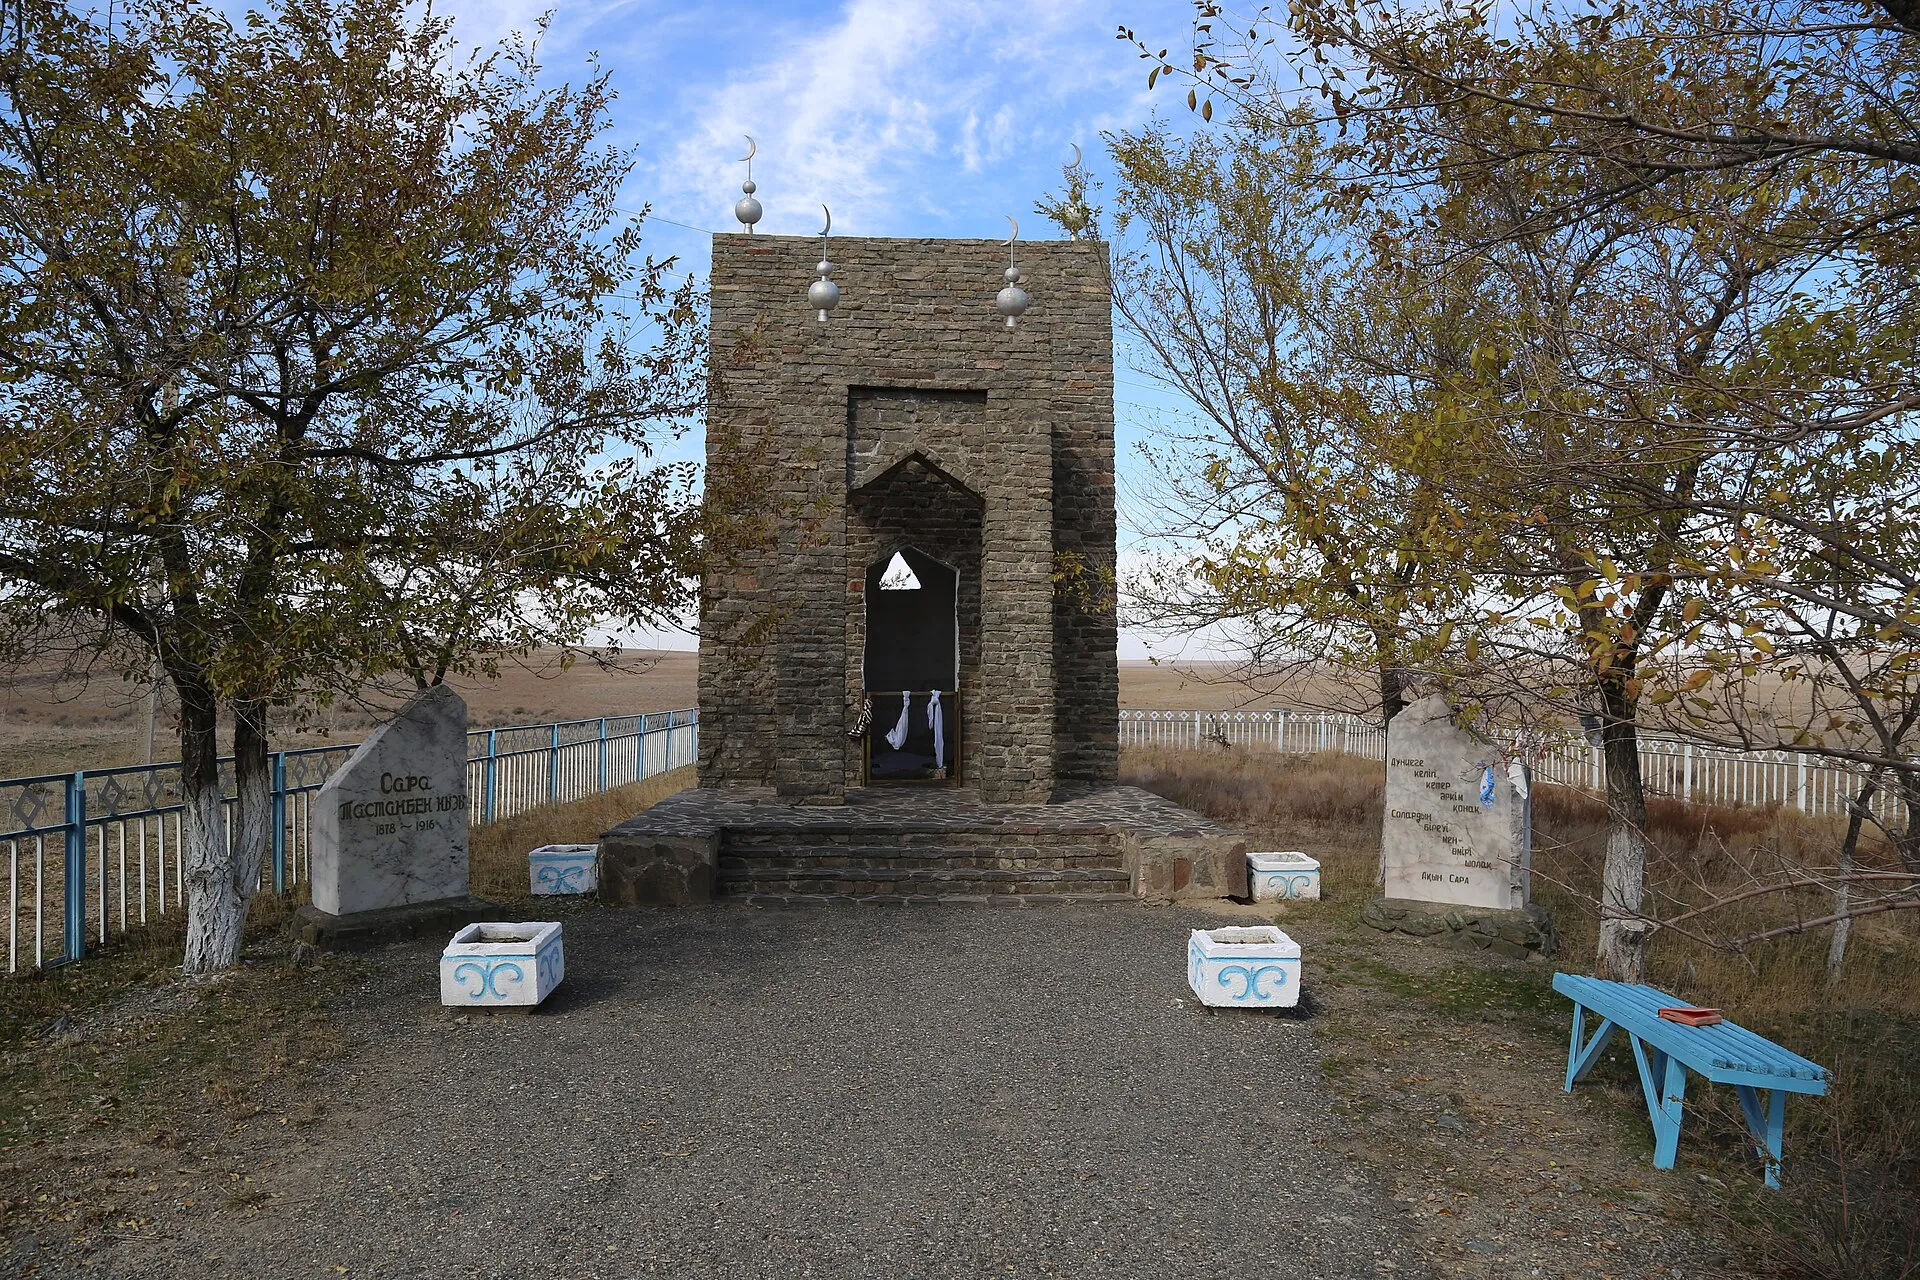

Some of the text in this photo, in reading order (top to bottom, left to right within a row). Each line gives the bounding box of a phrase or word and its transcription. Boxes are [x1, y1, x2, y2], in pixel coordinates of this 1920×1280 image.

[381, 772, 432, 794] Сара
[376, 824, 396, 836] 1878
[416, 820, 435, 832] 1916
